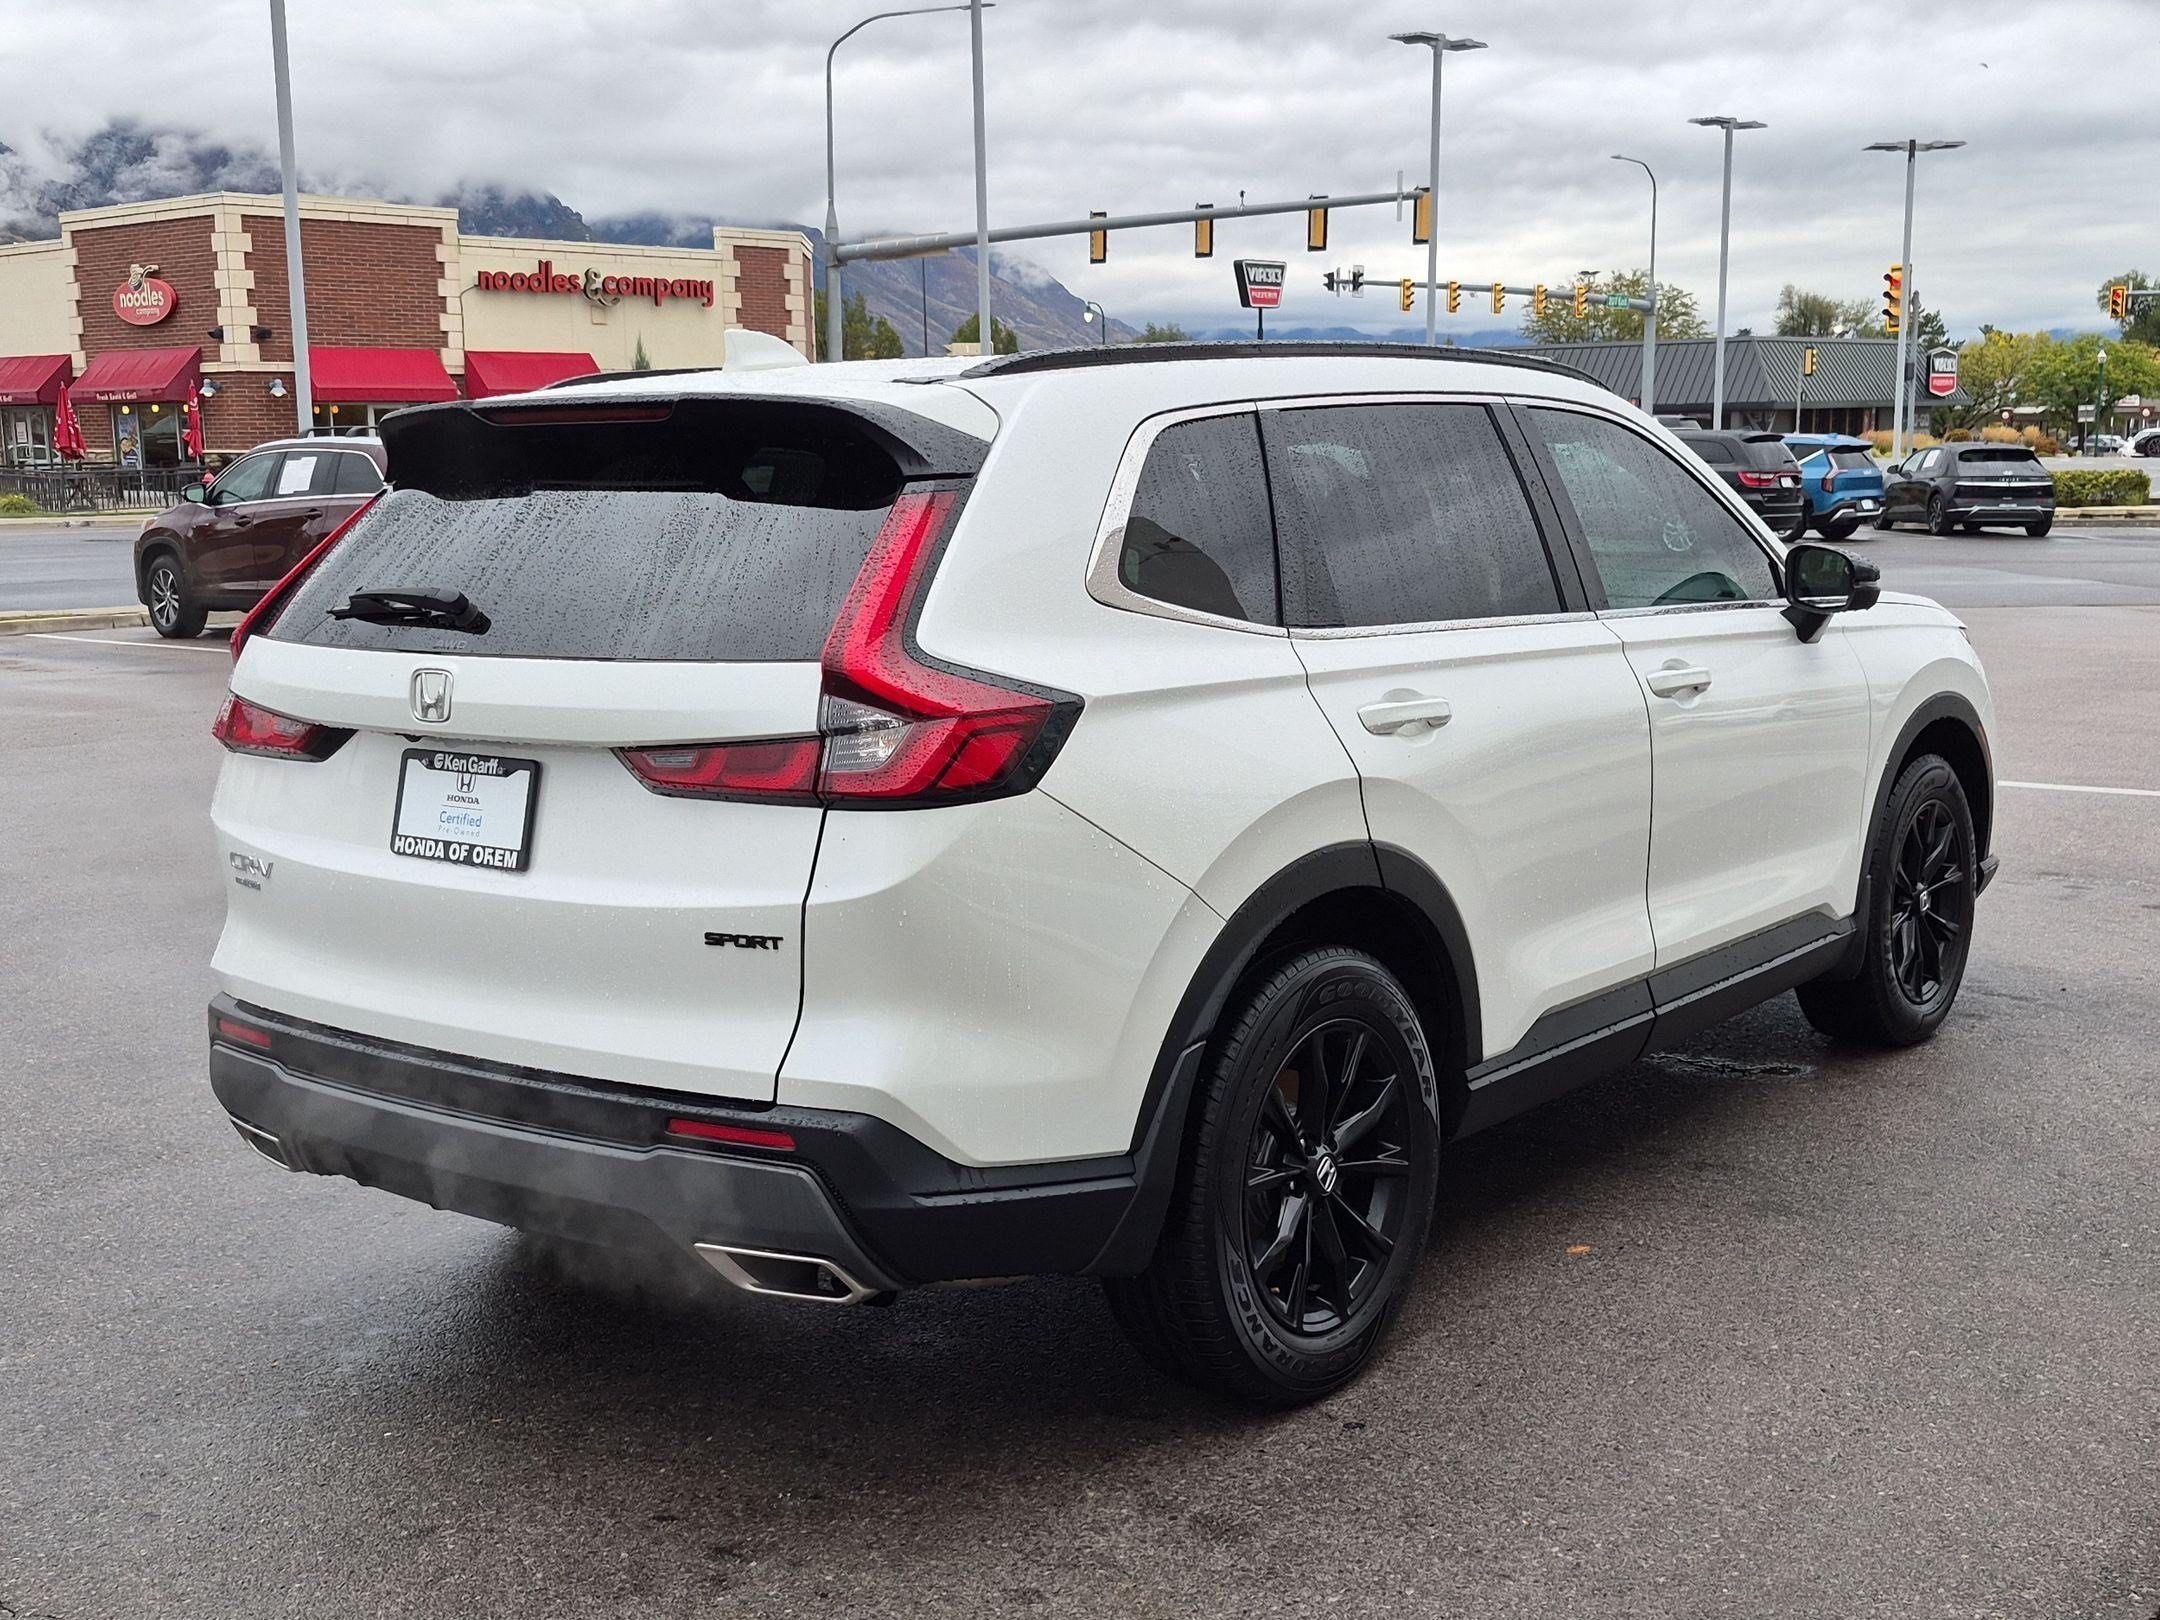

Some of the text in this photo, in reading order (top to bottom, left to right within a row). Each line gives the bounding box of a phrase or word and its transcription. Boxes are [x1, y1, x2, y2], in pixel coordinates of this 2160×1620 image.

[478, 259, 714, 308] noodles & company
[120, 282, 164, 308] noodles
[444, 753, 499, 775] Ken Garff
[446, 794, 480, 805] HONDA
[439, 810, 482, 828] Certified
[438, 826, 481, 838] Pre-Owned
[394, 836, 518, 869] HONDA OF OREM
[229, 851, 274, 880] CR-V
[704, 932, 784, 950] SPORT
